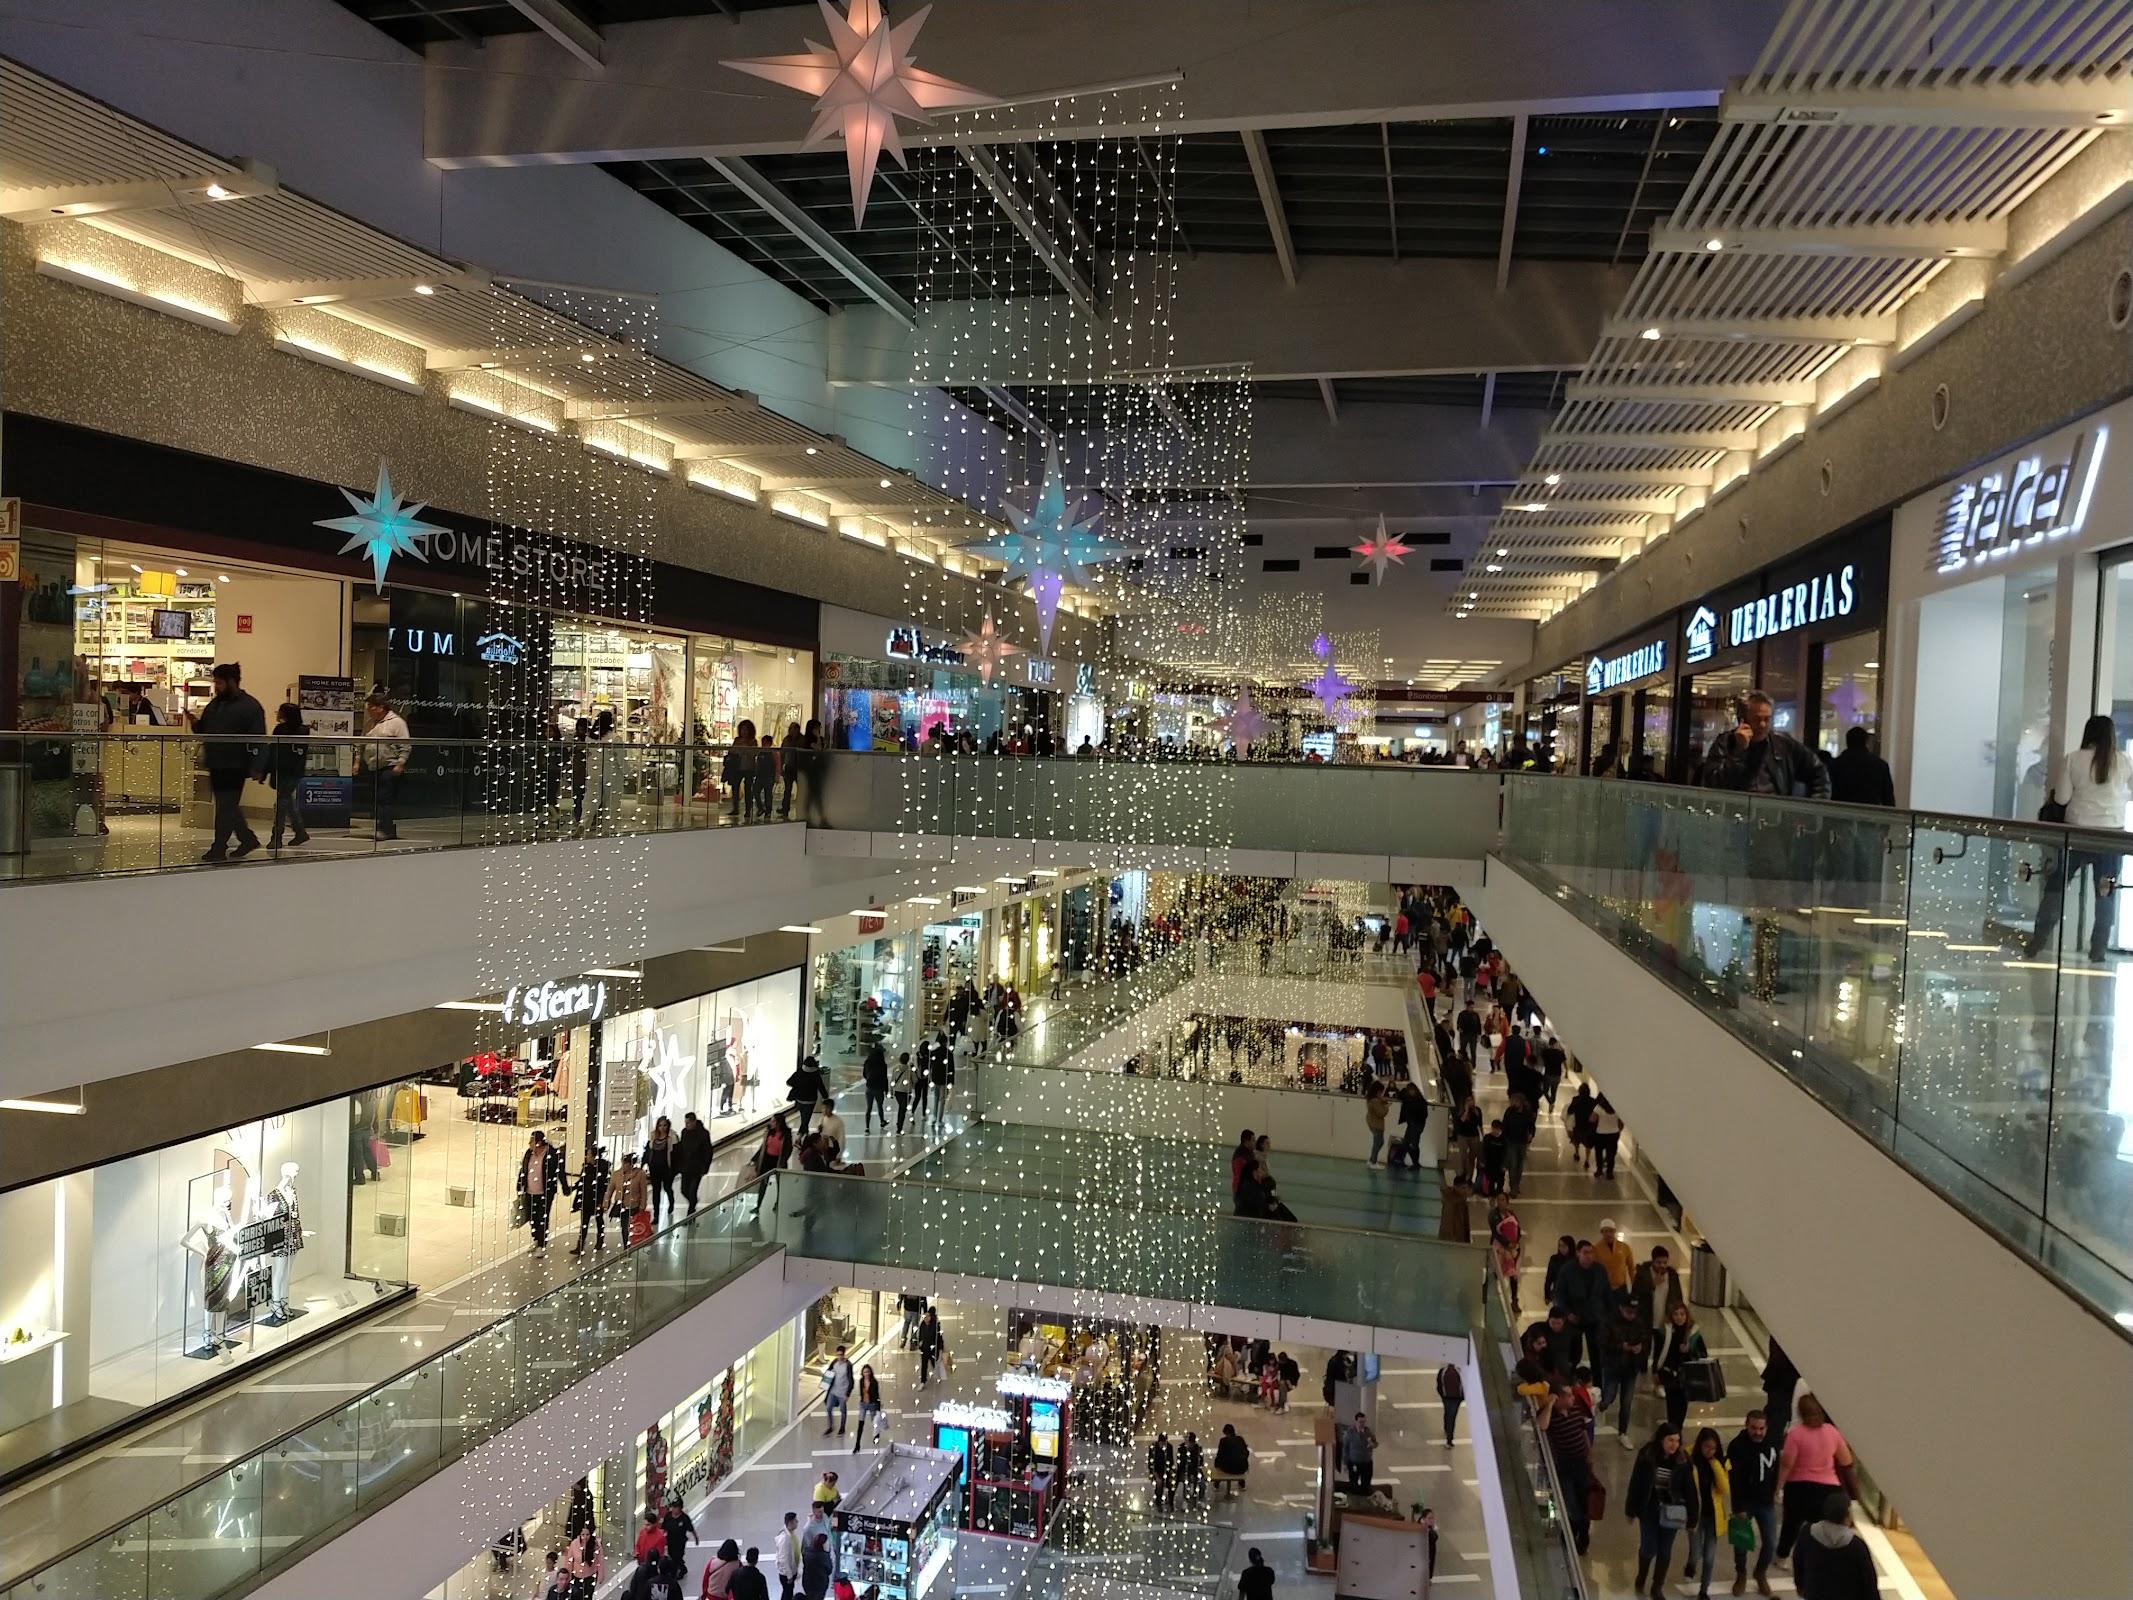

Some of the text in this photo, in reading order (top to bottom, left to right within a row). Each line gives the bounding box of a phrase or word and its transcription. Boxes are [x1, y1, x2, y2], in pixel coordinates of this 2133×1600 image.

[513, 544, 605, 590] STORE
[1603, 640, 1666, 688] MUEBLERIAS
[240, 1217, 285, 1244] CHRISTMAS
